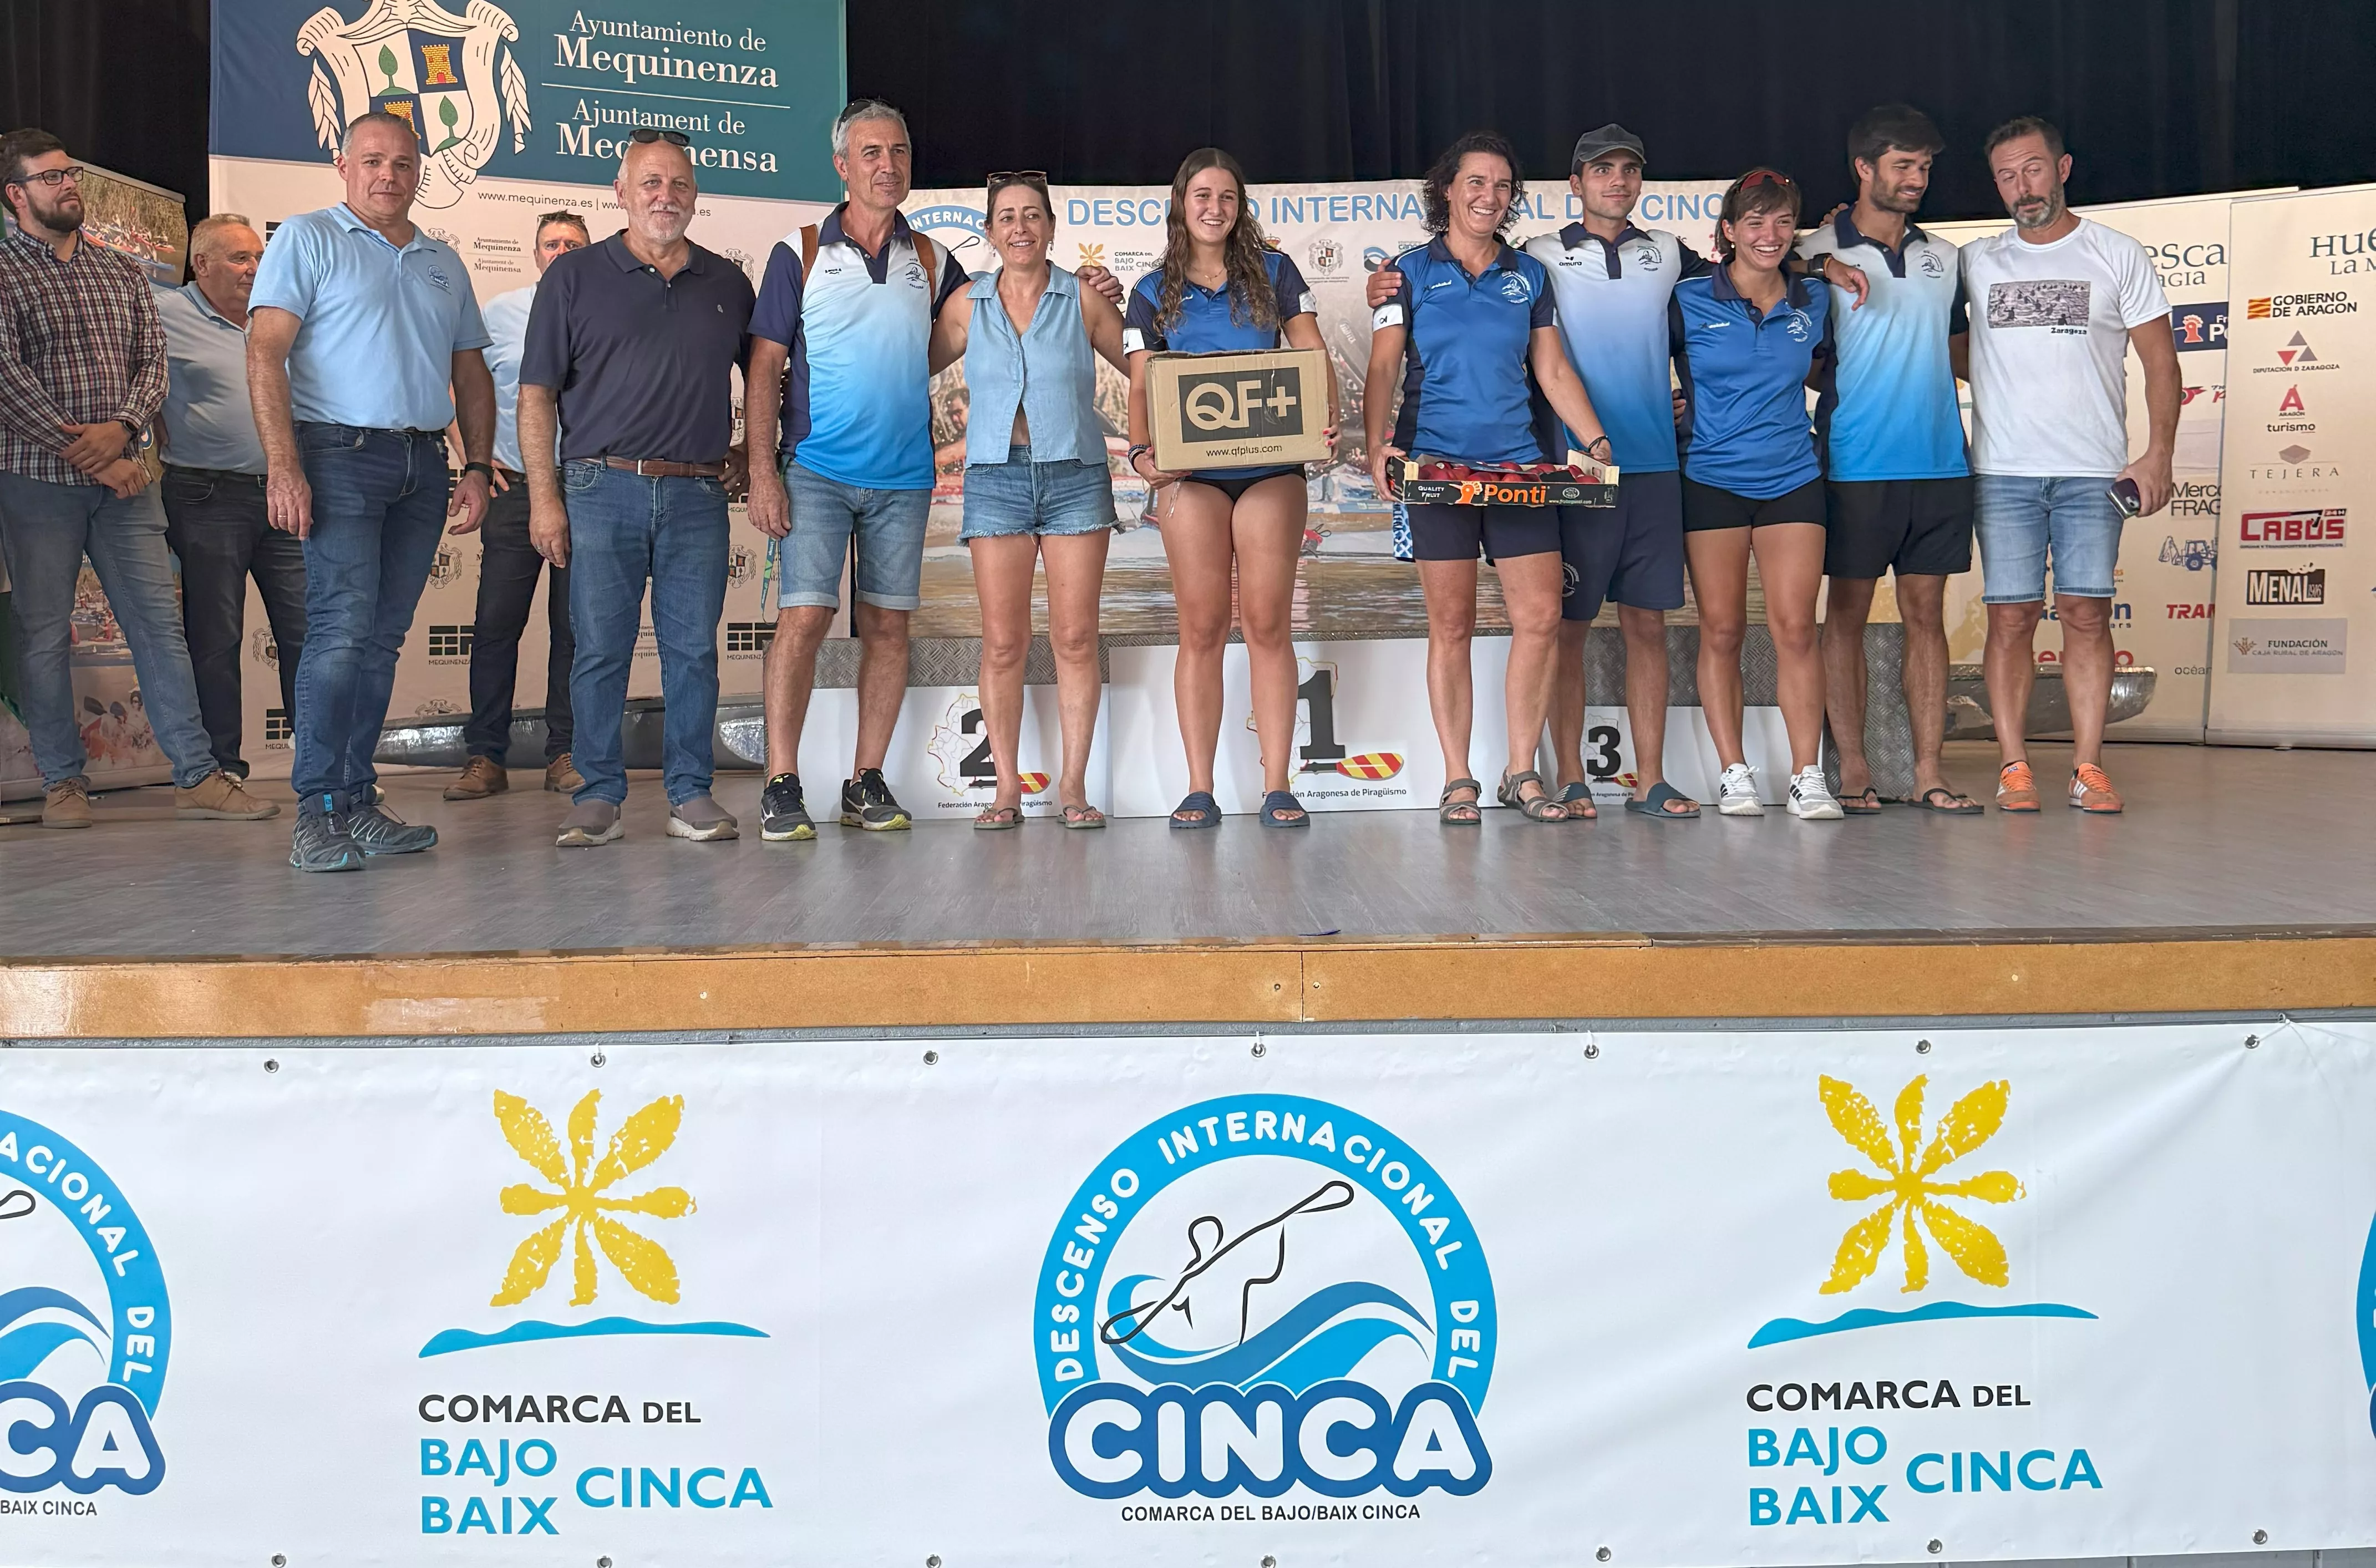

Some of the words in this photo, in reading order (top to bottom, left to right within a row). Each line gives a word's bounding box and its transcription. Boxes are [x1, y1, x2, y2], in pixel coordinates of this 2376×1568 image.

[569, 10, 732, 48] Ayuntamiento
[739, 28, 766, 52] de
[554, 34, 779, 88] Mequinenza
[572, 98, 711, 133] Ajuntament
[718, 111, 745, 135] de
[556, 123, 778, 172] Menensa
[478, 191, 593, 209] www.mequinenza.es
[1641, 193, 1724, 221] CINC
[474, 242, 521, 252] Mequinenza
[474, 263, 521, 273] Mequinensa
[2272, 307, 2291, 318] DE
[2296, 302, 2357, 316] ARAGON
[2273, 291, 2348, 306] GOBIERNO
[2267, 422, 2316, 432] turismo
[1206, 444, 1282, 458] www.qfplus.com
[2250, 467, 2339, 479] TEJERA
[1485, 484, 1546, 504] Ponti
[2249, 571, 2321, 602] MENAL
[2268, 638, 2328, 648] FUNDACIÓN
[1298, 669, 1346, 760] 1
[959, 708, 996, 777] 2
[1587, 725, 1621, 777] 3
[1021, 799, 1053, 808] iragüismo
[1307, 790, 1349, 799] Aragonesa
[1362, 788, 1407, 798] Piragüismo
[1050, 1168, 1140, 1383] DESCENSO
[1157, 1110, 1463, 1271] INTERNACIONAL
[1448, 1299, 1480, 1379] DEL
[123, 1306, 155, 1383] DEL
[418, 1394, 630, 1423] COMARCA
[643, 1402, 701, 1424] DEL
[1746, 1379, 1960, 1412] COMARCA
[1973, 1385, 2030, 1407] DEL
[1059, 1393, 1481, 1486] CINCA
[1748, 1425, 1888, 1476] BAJO
[420, 1438, 557, 1486] BAJO
[1906, 1448, 2103, 1494] CINCA
[575, 1466, 774, 1508] CINCA
[43, 1500, 98, 1516] CINCA
[421, 1496, 560, 1535] BAIX
[1121, 1505, 1215, 1521] COMARCA
[1220, 1505, 1257, 1521] DEL
[1261, 1504, 1358, 1521] BAJO/BAIX
[1362, 1504, 1421, 1520] CINCA
[1749, 1484, 1890, 1526] BAIX
